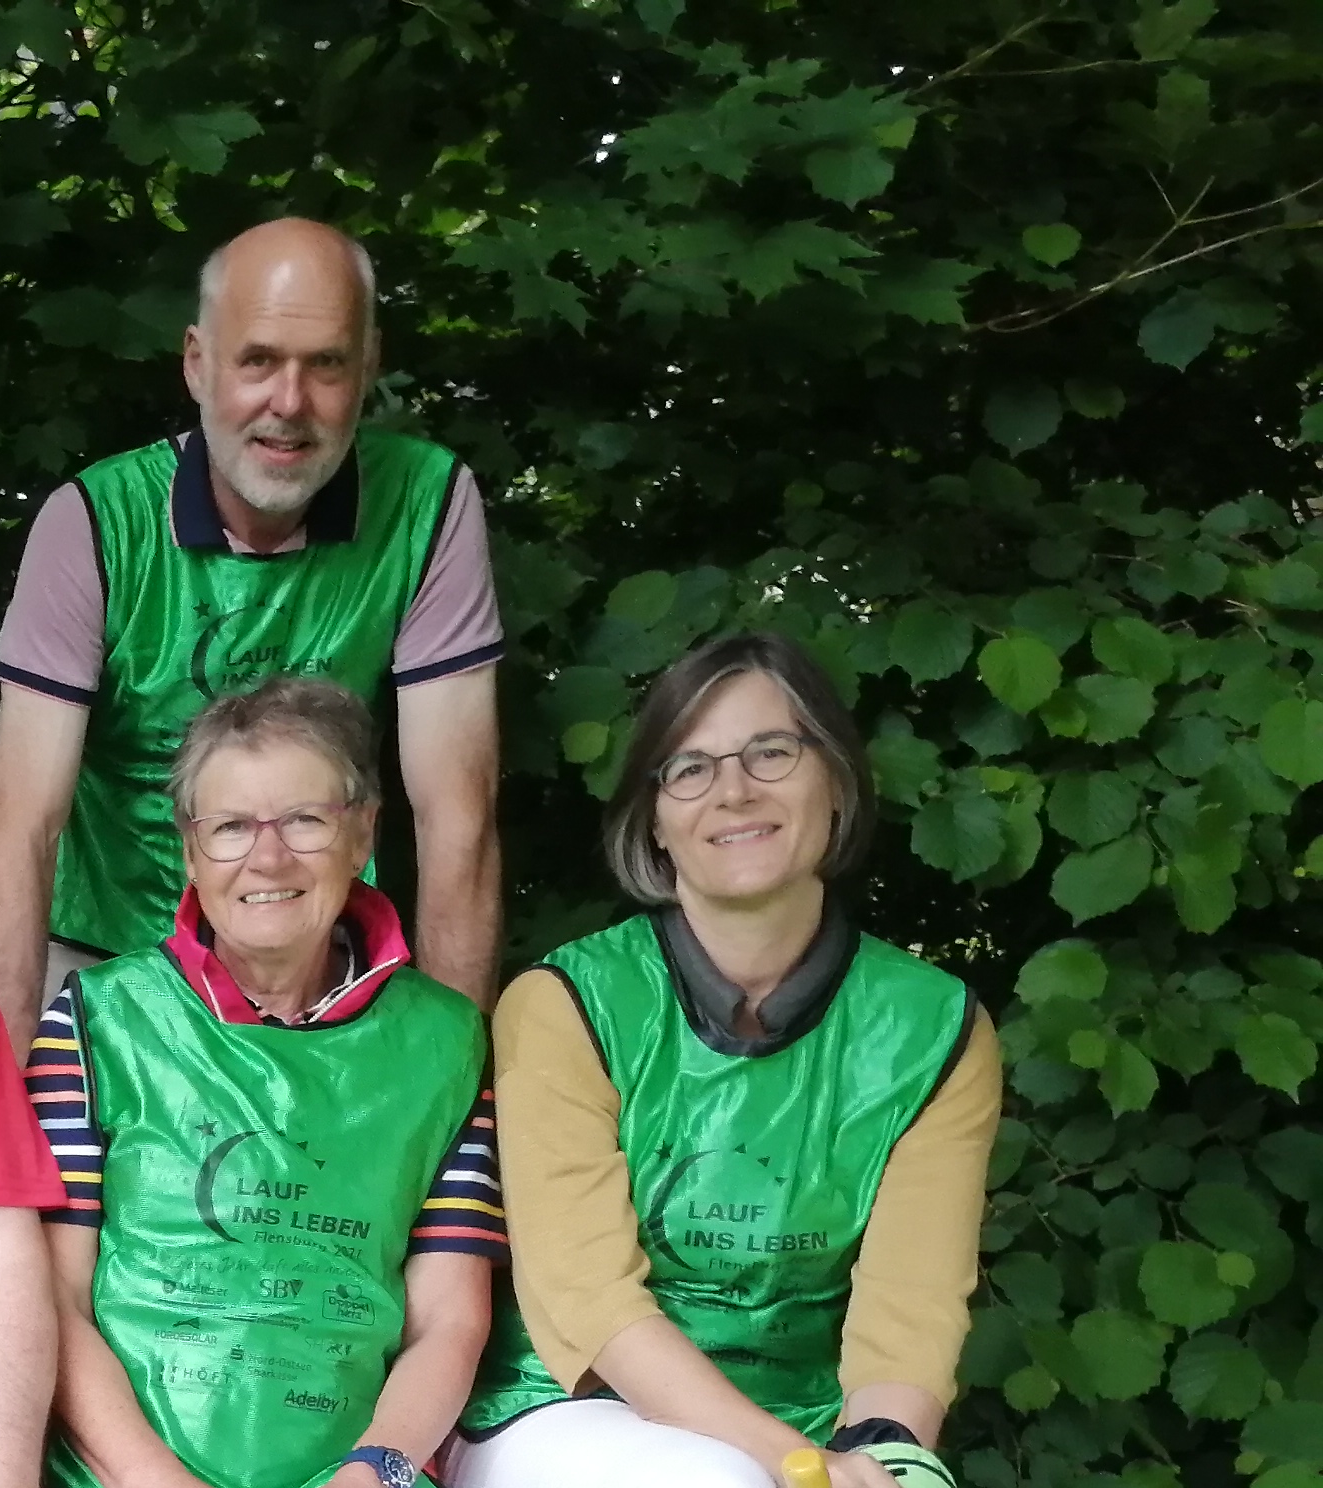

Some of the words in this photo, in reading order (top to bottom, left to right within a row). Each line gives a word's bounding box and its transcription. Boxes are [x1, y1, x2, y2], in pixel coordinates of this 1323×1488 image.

[236, 1178, 309, 1201] LAUF
[233, 1205, 280, 1225] INS
[291, 1211, 371, 1240] LEBEN
[688, 1200, 767, 1222] LAUF
[684, 1229, 735, 1250] INS
[747, 1230, 829, 1252] LEBEN
[259, 1278, 304, 1299] SBV
[284, 1389, 339, 1414] Adelby
